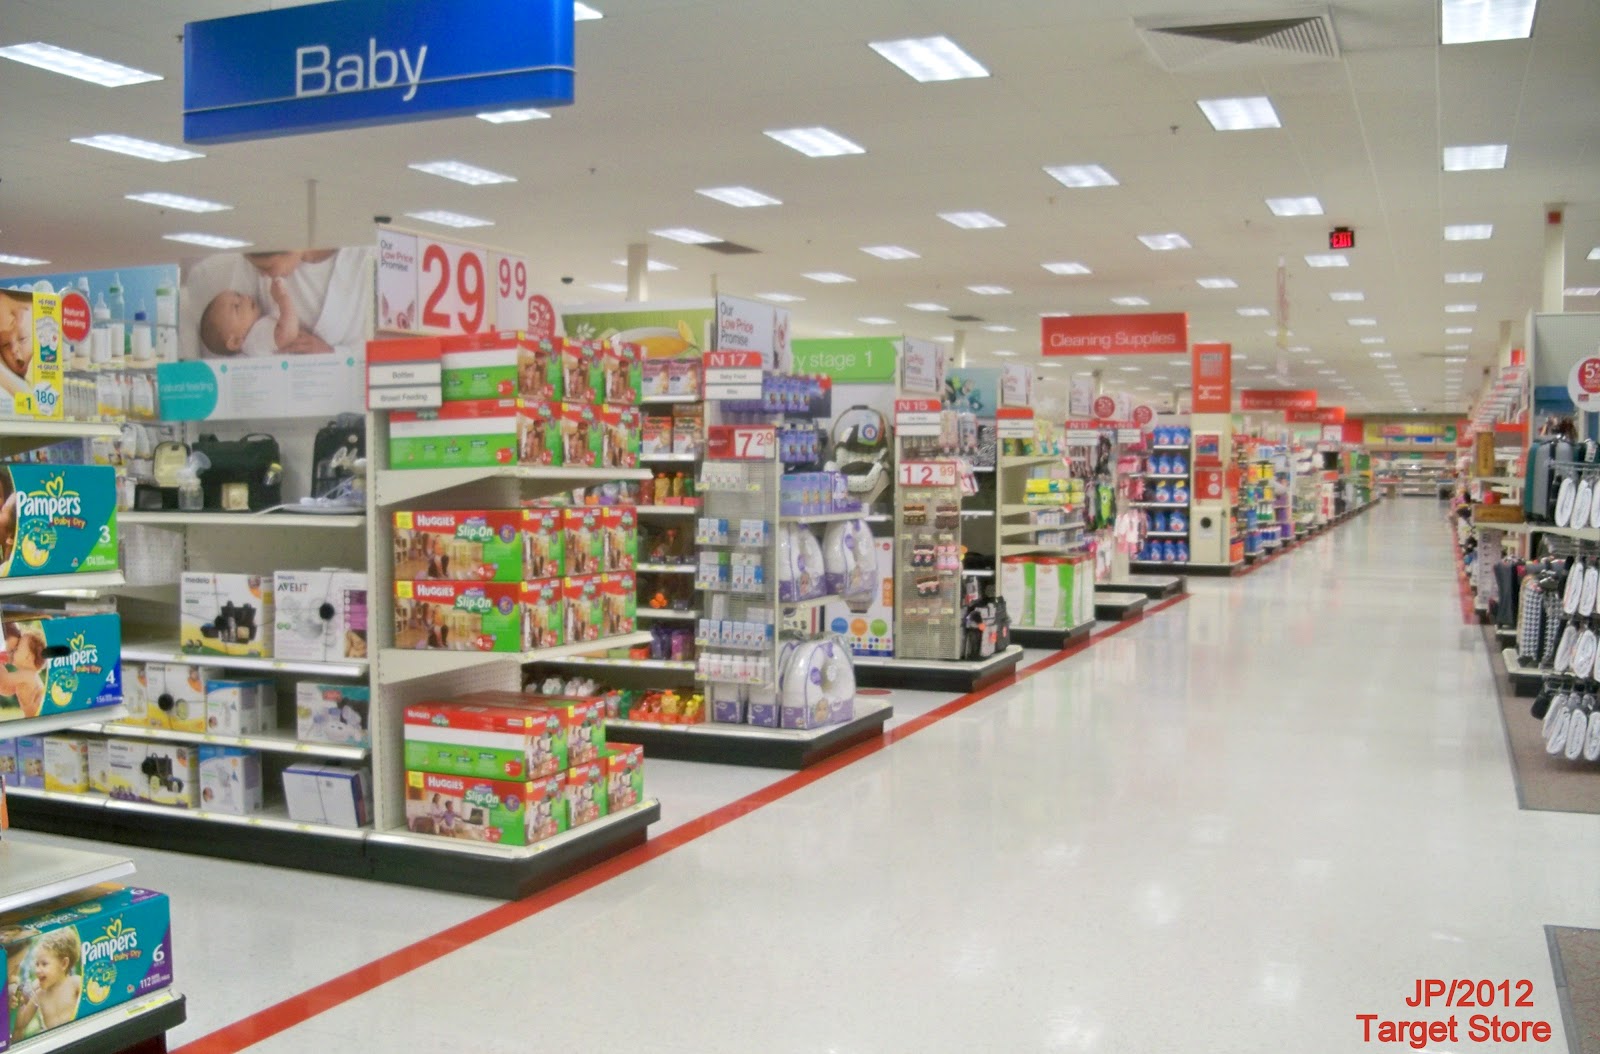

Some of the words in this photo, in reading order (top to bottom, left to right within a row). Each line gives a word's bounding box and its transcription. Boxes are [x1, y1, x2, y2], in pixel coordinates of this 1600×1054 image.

[296, 38, 427, 101] Baby
[380, 239, 393, 250] Our
[380, 250, 396, 261] Low
[396, 252, 413, 264] Price
[499, 258, 527, 300] 99
[63, 308, 85, 317] Natural
[720, 301, 734, 316] Our
[63, 319, 86, 330] Feeding
[720, 318, 735, 330] Low
[736, 320, 754, 334] Price
[1050, 333, 1112, 349] Cleaning
[1115, 331, 1176, 348] Supplies
[729, 353, 748, 366] 17
[809, 352, 856, 369] stage
[864, 350, 873, 368] 1
[36, 389, 55, 405] 180
[738, 433, 753, 457] 7
[757, 432, 773, 446] 29
[16, 490, 82, 523] Pampers
[53, 517, 70, 528] Baby
[73, 518, 86, 529] Dry
[99, 525, 111, 543] 3
[457, 525, 493, 539] Slip-On
[277, 582, 308, 593] AVENT
[456, 595, 492, 609] Slip-On
[105, 669, 116, 684] 4
[465, 789, 499, 805] Slip-On
[81, 931, 138, 965] Pampers
[130, 949, 142, 958] Dry
[152, 943, 165, 962] 6
[140, 977, 151, 989] 112
